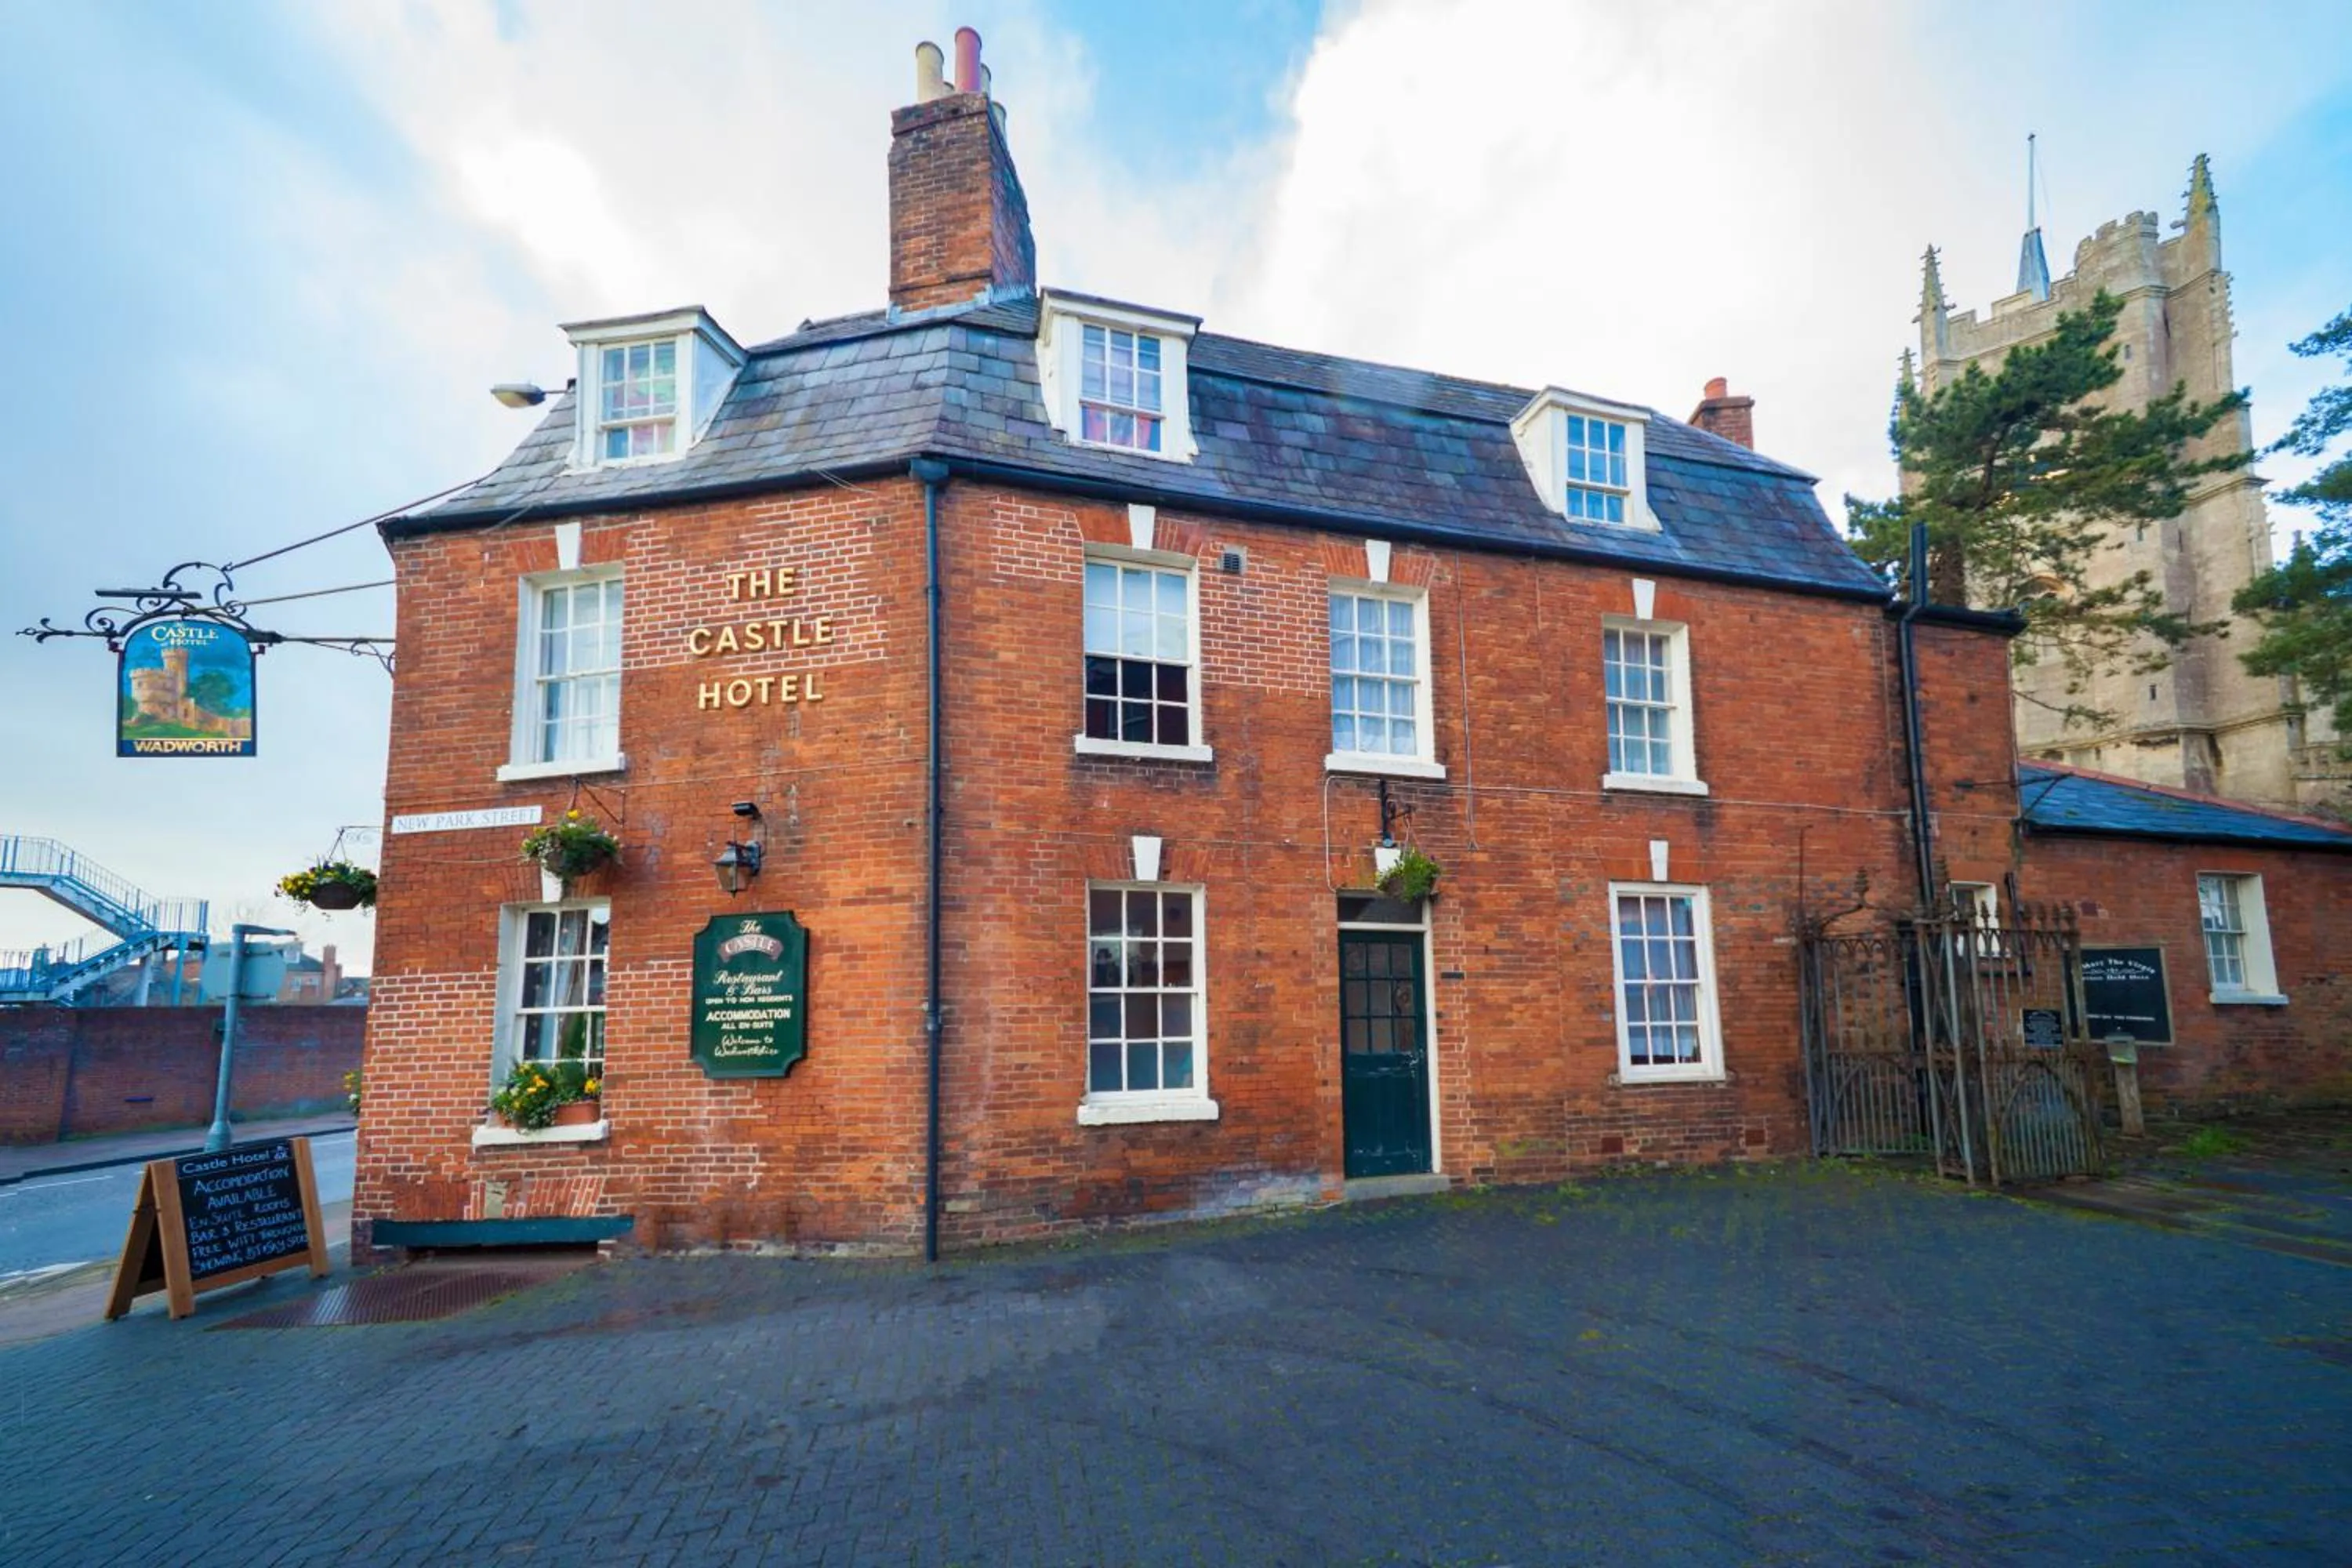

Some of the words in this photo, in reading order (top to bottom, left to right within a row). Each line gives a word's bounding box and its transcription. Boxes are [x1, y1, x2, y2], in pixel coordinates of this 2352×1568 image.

[726, 568, 795, 601] THE
[151, 626, 220, 641] CASTLE
[689, 616, 833, 655] CASTLE
[699, 673, 823, 710] HOTEL
[133, 739, 242, 753] WADWORTH
[397, 818, 429, 830] NEW
[436, 815, 475, 828] PARK
[482, 809, 537, 825] STREET
[739, 920, 762, 934] The
[725, 938, 776, 954] CASTLE
[713, 970, 783, 985] Restaurant
[741, 984, 771, 995] Bars
[706, 1008, 790, 1022] ACCOMMODATION
[182, 1159, 227, 1174] Castle
[232, 1151, 270, 1165] Hotel
[208, 1185, 277, 1209] AVAILABLE
